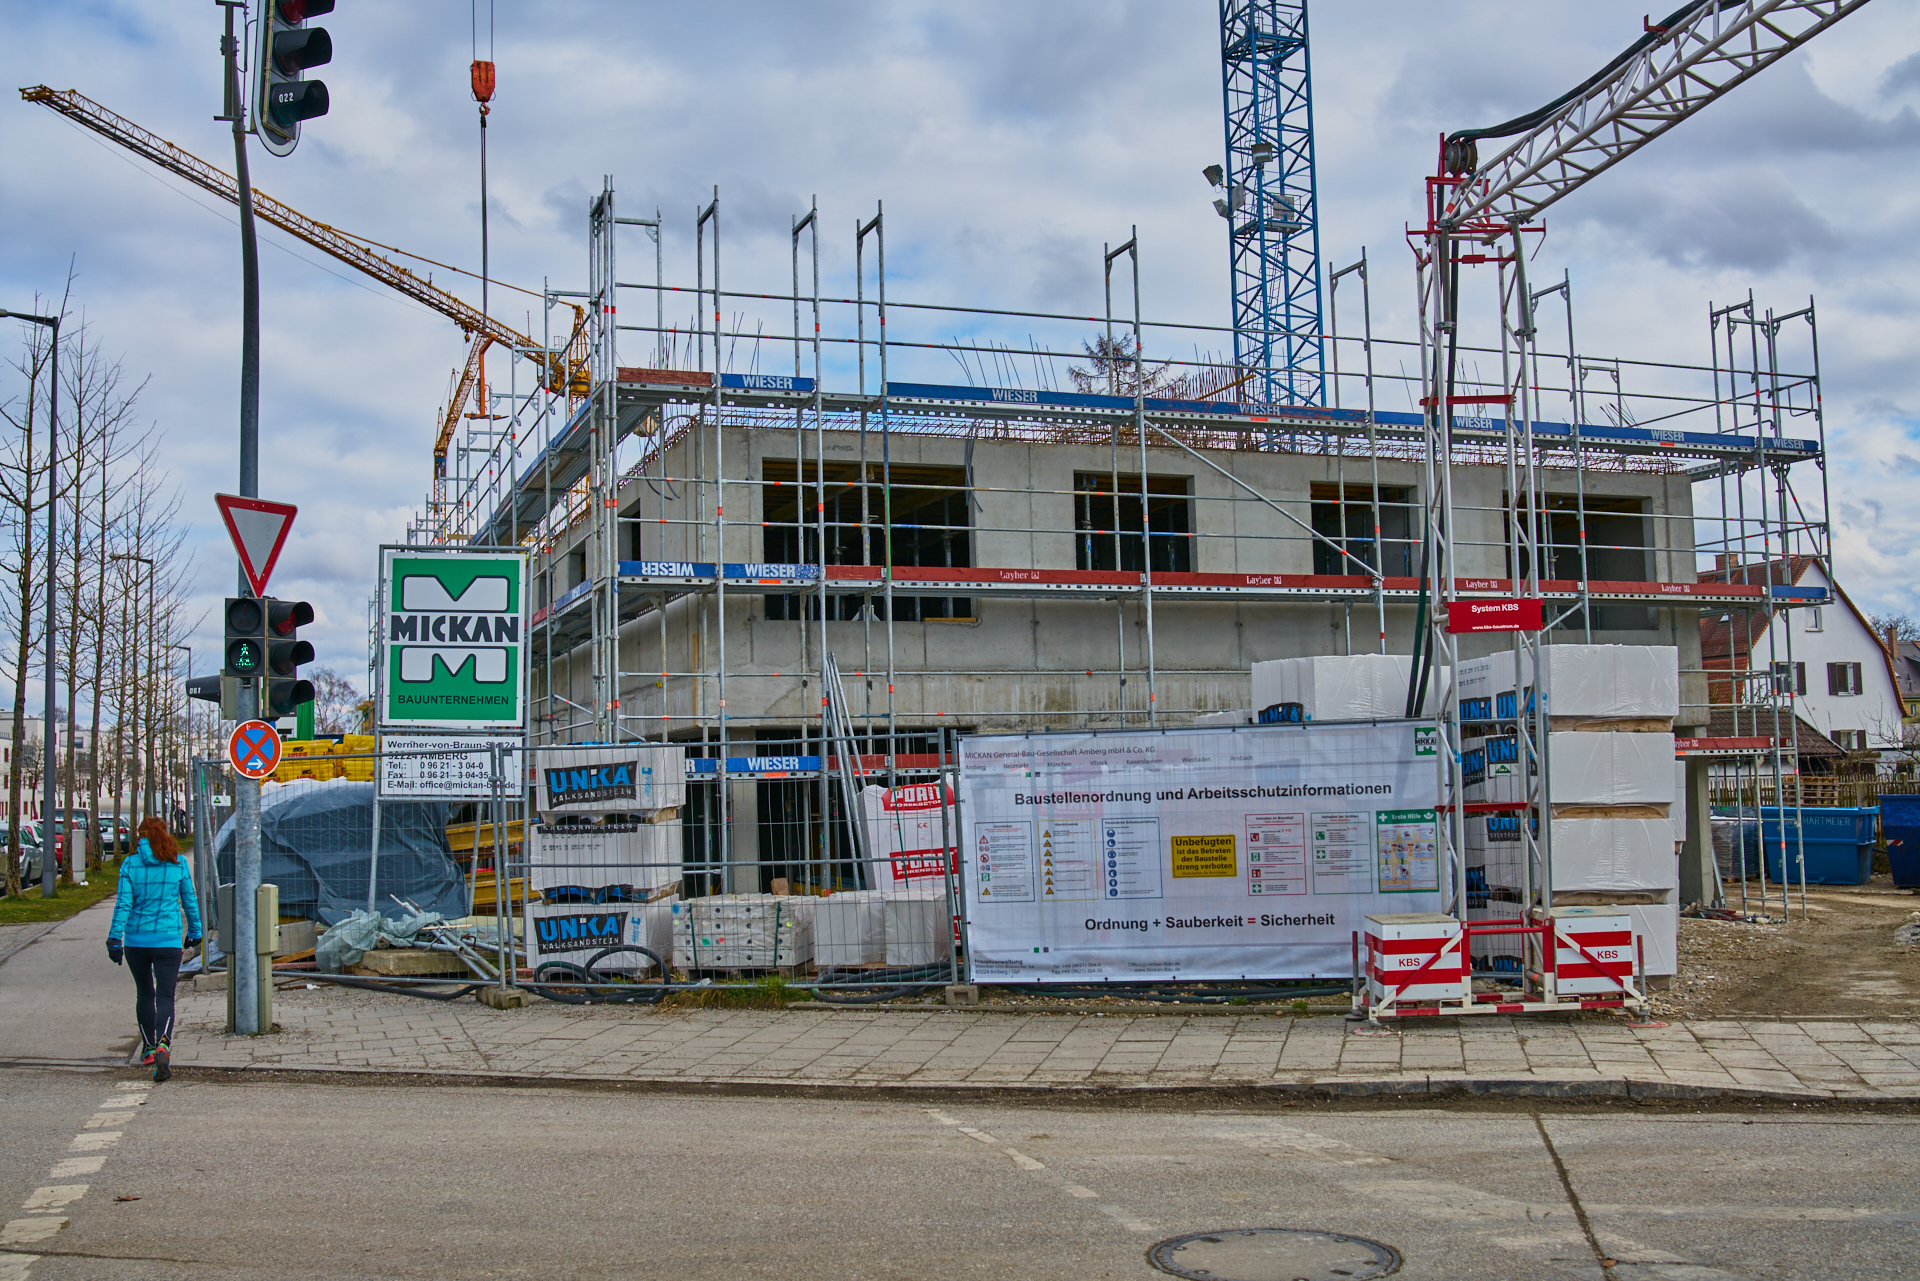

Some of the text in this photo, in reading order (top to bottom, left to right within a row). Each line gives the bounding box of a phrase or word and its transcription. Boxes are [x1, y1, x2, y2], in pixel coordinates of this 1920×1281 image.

[279, 92, 294, 103] 022
[742, 375, 793, 389] WIESER
[992, 388, 1038, 403] WIESER
[1239, 403, 1280, 416] WIESER
[1455, 415, 1493, 429] WIESER
[1650, 428, 1685, 442] WIESER
[1772, 438, 1805, 450] WIESER
[641, 561, 695, 577] WIESER
[744, 563, 796, 578] WIESER
[1000, 570, 1029, 580] Layher
[1246, 575, 1273, 585] Layher
[1465, 580, 1490, 590] Layher
[1661, 584, 1683, 593] Layher
[1471, 603, 1519, 613] System KBS
[391, 615, 518, 643] MICKAN
[398, 695, 509, 705] BAUUNTERNEHMEN
[1674, 738, 1691, 749] ayher
[420, 751, 468, 760] AMBERG
[993, 749, 1077, 758] General-Bau-Gesellschaft
[1079, 748, 1106, 756] Amberg
[747, 757, 799, 771] WIESER
[388, 771, 407, 779] Fax:
[388, 781, 417, 789] E-Mail:
[552, 788, 632, 804] KALKSANDSTEIN
[891, 786, 942, 803] PORIT
[1014, 783, 1392, 806] Baustellenordnung und Arbeitsschutzinformationen
[1803, 816, 1850, 826] HARTMEIER
[1175, 837, 1232, 847] Unbefugten
[1085, 918, 1148, 932] Ordnung
[1153, 919, 1161, 927] +
[1165, 915, 1244, 928] Sauberkeit
[1260, 913, 1335, 926] Sicherheit
[542, 937, 619, 950] KALKSANDSTEIN
[1597, 950, 1618, 959] KBS
[1399, 958, 1420, 967] KBS
